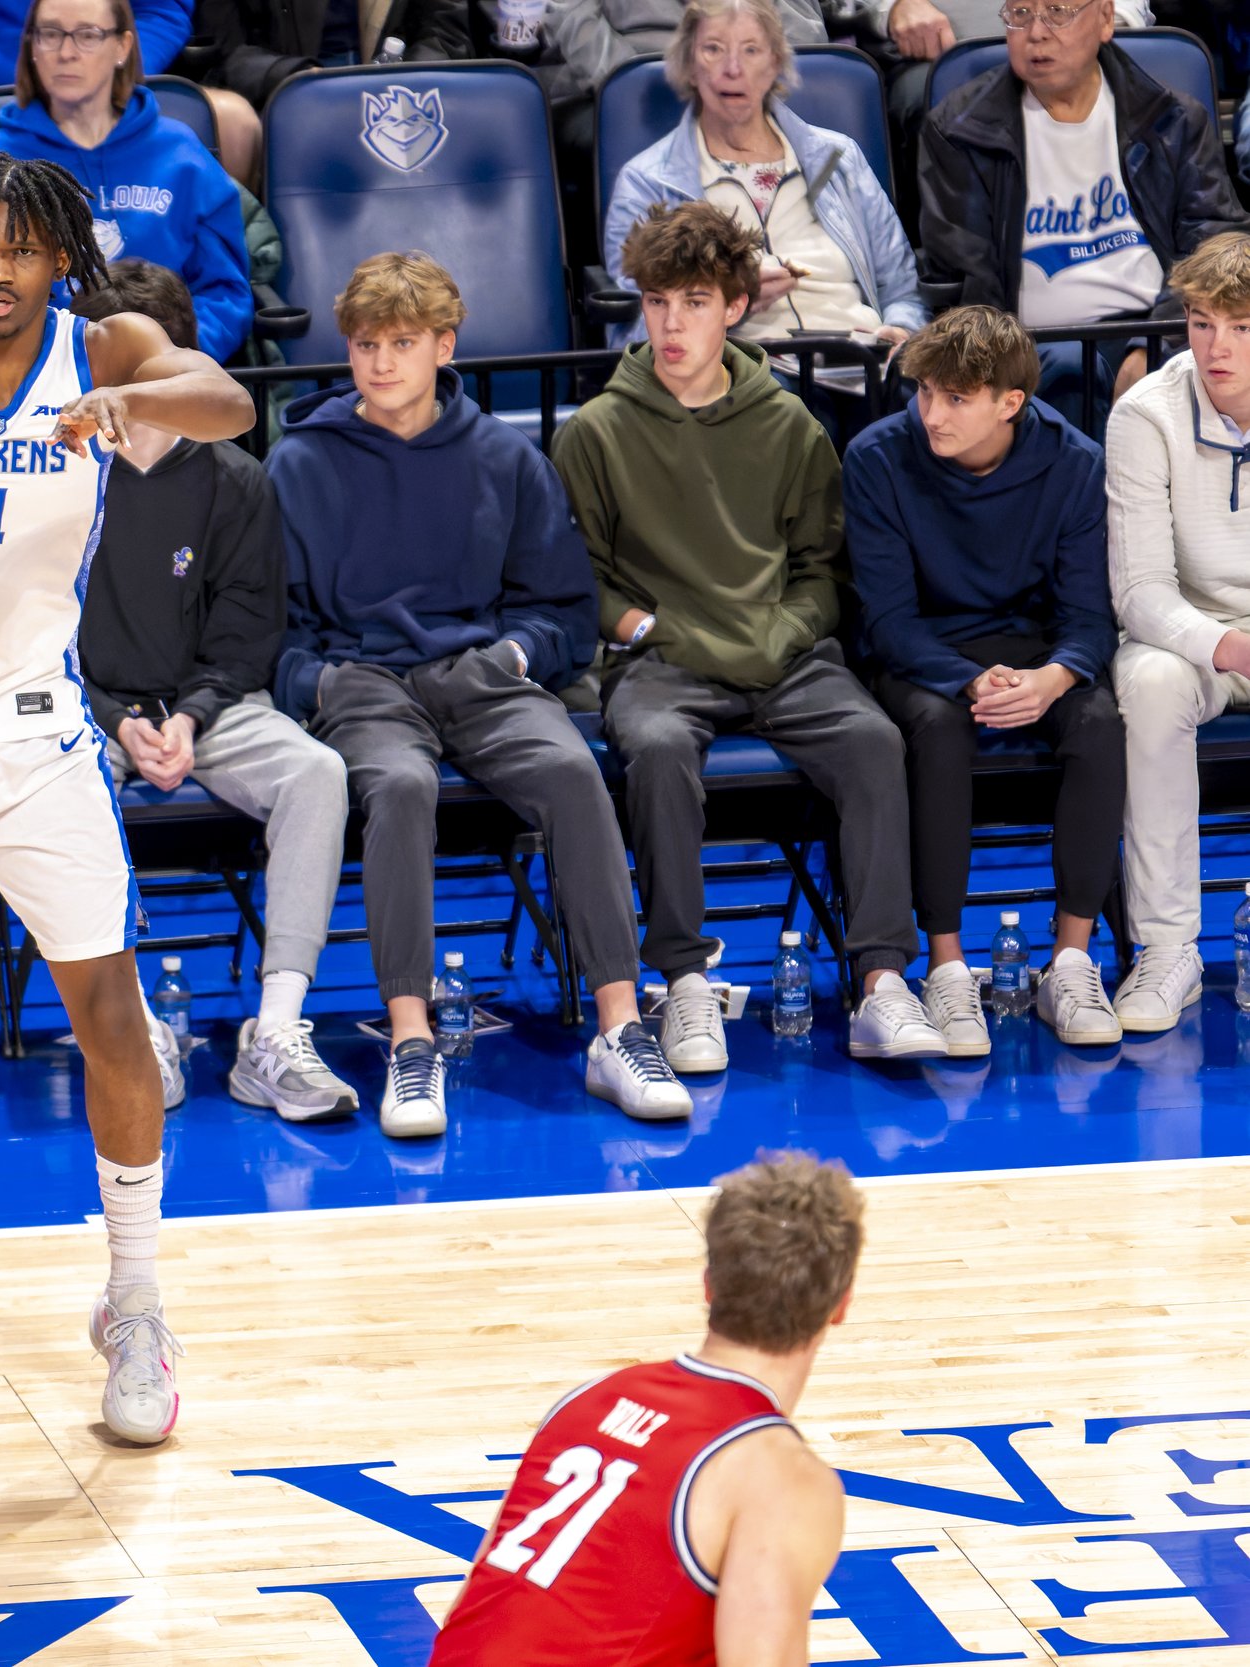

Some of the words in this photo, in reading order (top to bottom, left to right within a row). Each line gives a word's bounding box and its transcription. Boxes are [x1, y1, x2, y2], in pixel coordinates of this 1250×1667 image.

[99, 185, 173, 215] LOUIS
[1088, 175, 1136, 232] Lo
[1070, 232, 1139, 259] BILLIKENS
[44, 698, 52, 707] M
[597, 1397, 670, 1448] WALZ
[485, 1443, 640, 1590] 21
